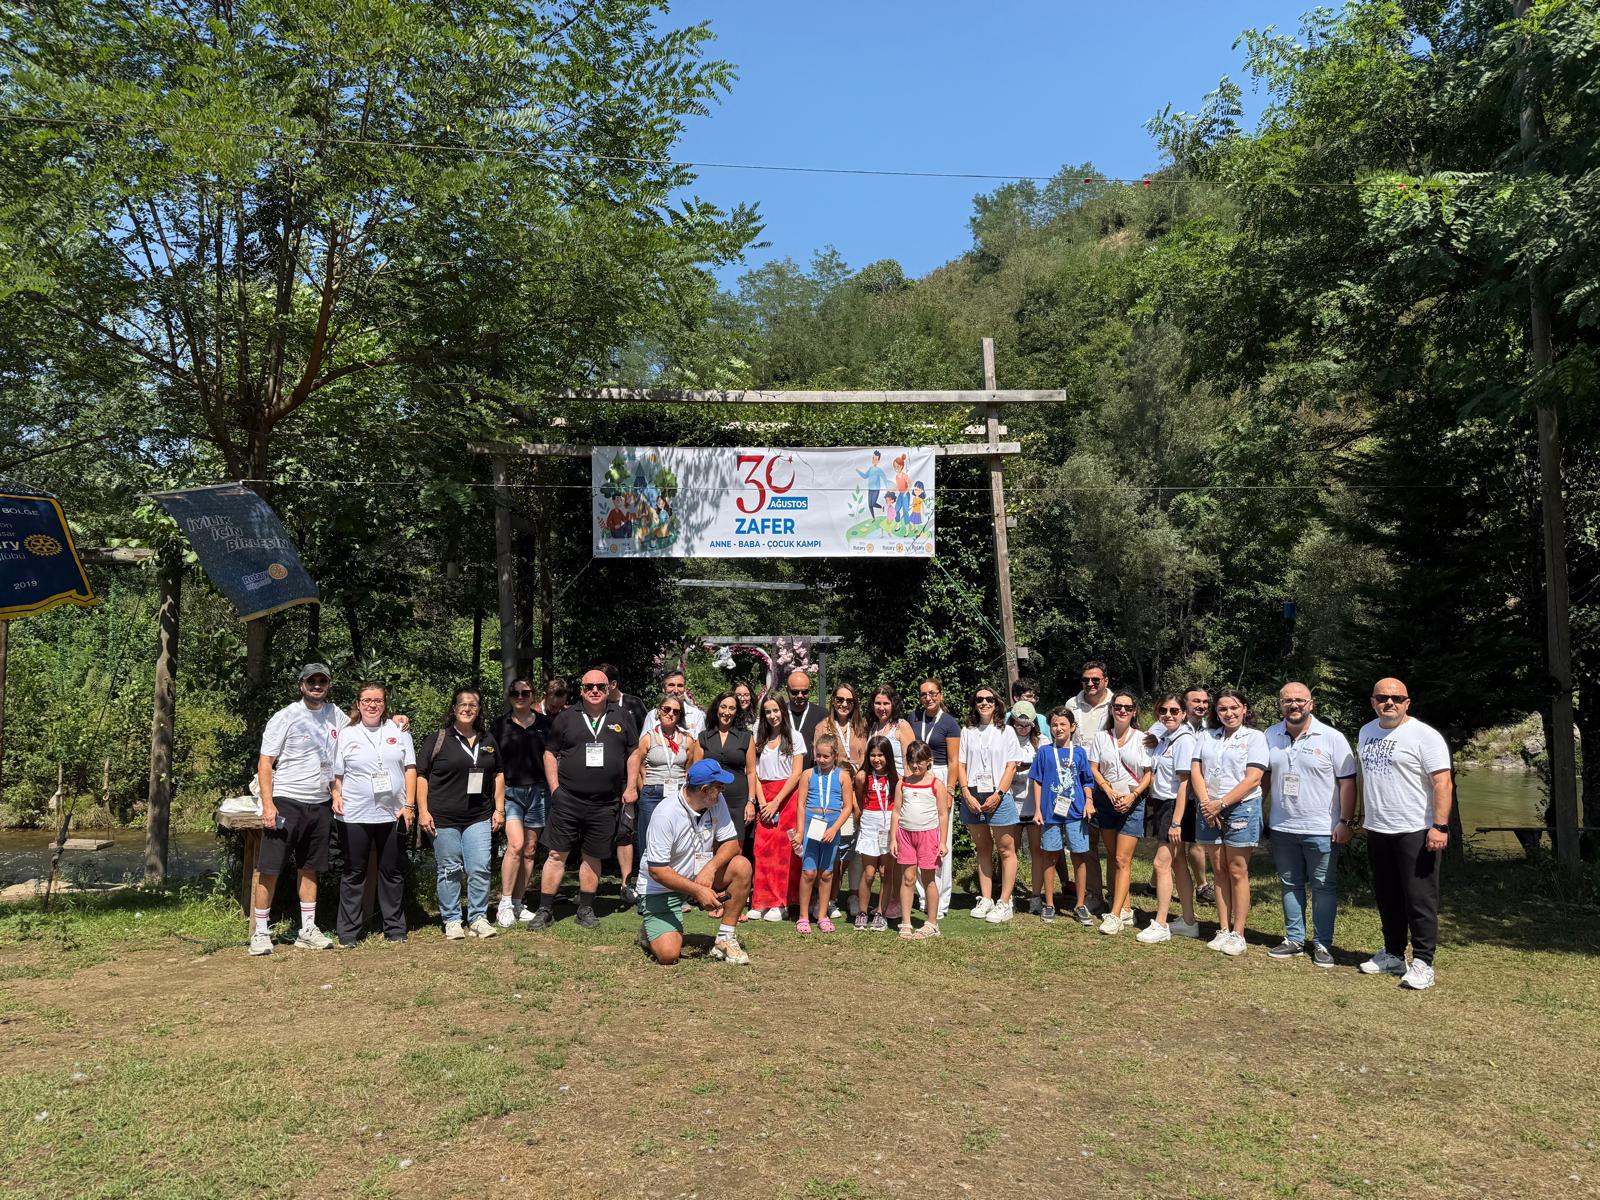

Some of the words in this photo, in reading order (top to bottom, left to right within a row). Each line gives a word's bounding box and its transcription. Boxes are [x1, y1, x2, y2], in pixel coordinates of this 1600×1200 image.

[736, 454, 796, 515] 30
[770, 500, 807, 509] AĞUSTOS
[735, 518, 795, 535] ZAFER
[709, 540, 732, 548] ANNE
[738, 540, 760, 548] BABA
[767, 540, 794, 550] ÇOCUK
[796, 540, 822, 548] KAMPI
[242, 570, 269, 585] Rotary
[13, 580, 39, 590] 2019
[1364, 736, 1398, 750] LACOSTE
